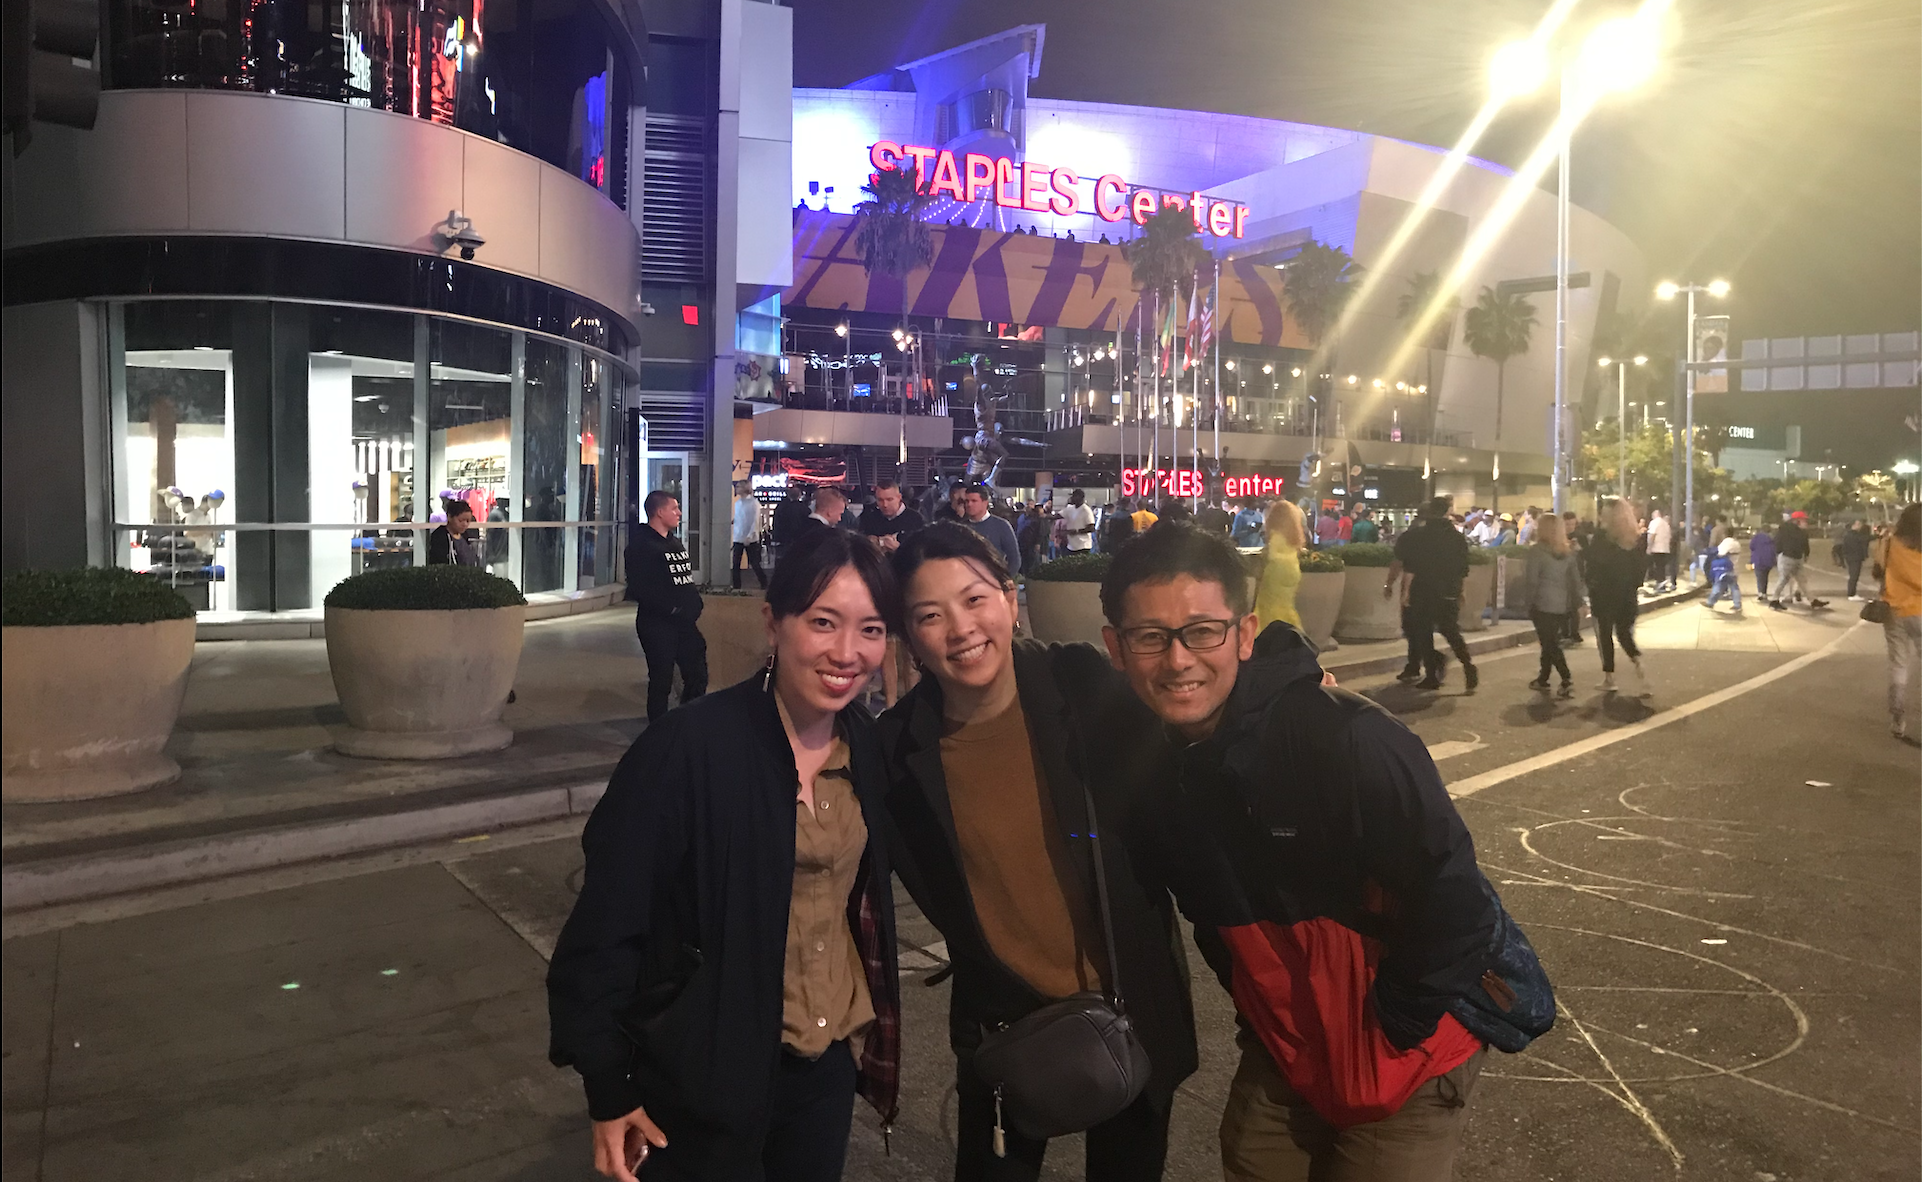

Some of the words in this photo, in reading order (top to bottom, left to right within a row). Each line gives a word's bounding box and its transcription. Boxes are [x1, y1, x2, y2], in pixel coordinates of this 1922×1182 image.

[784, 207, 1284, 347] AKES
[1728, 425, 1755, 439] CENTER
[1221, 470, 1284, 497] enter
